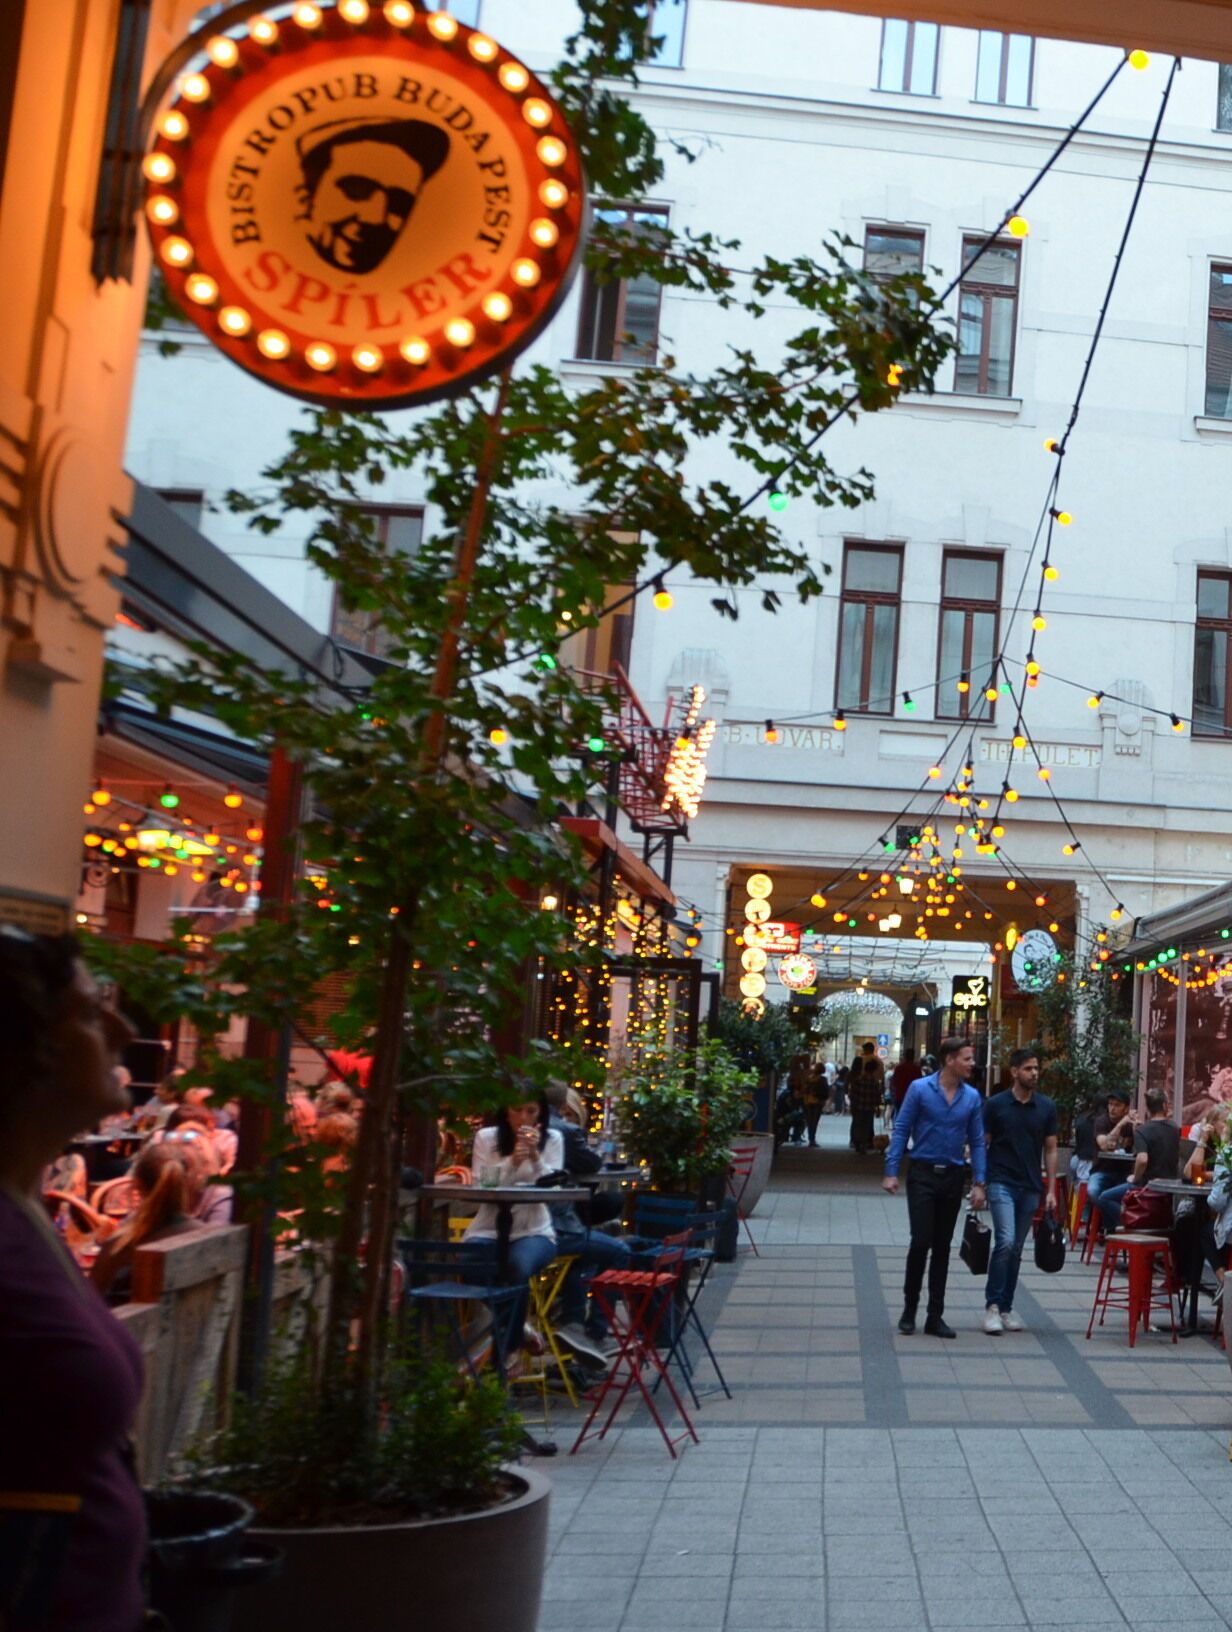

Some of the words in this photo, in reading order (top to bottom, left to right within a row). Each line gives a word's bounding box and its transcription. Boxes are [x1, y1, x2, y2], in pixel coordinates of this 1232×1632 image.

[226, 72, 380, 248] BISTROPUB
[392, 75, 511, 255] BUDAPEST
[243, 250, 493, 331] SPÍLER
